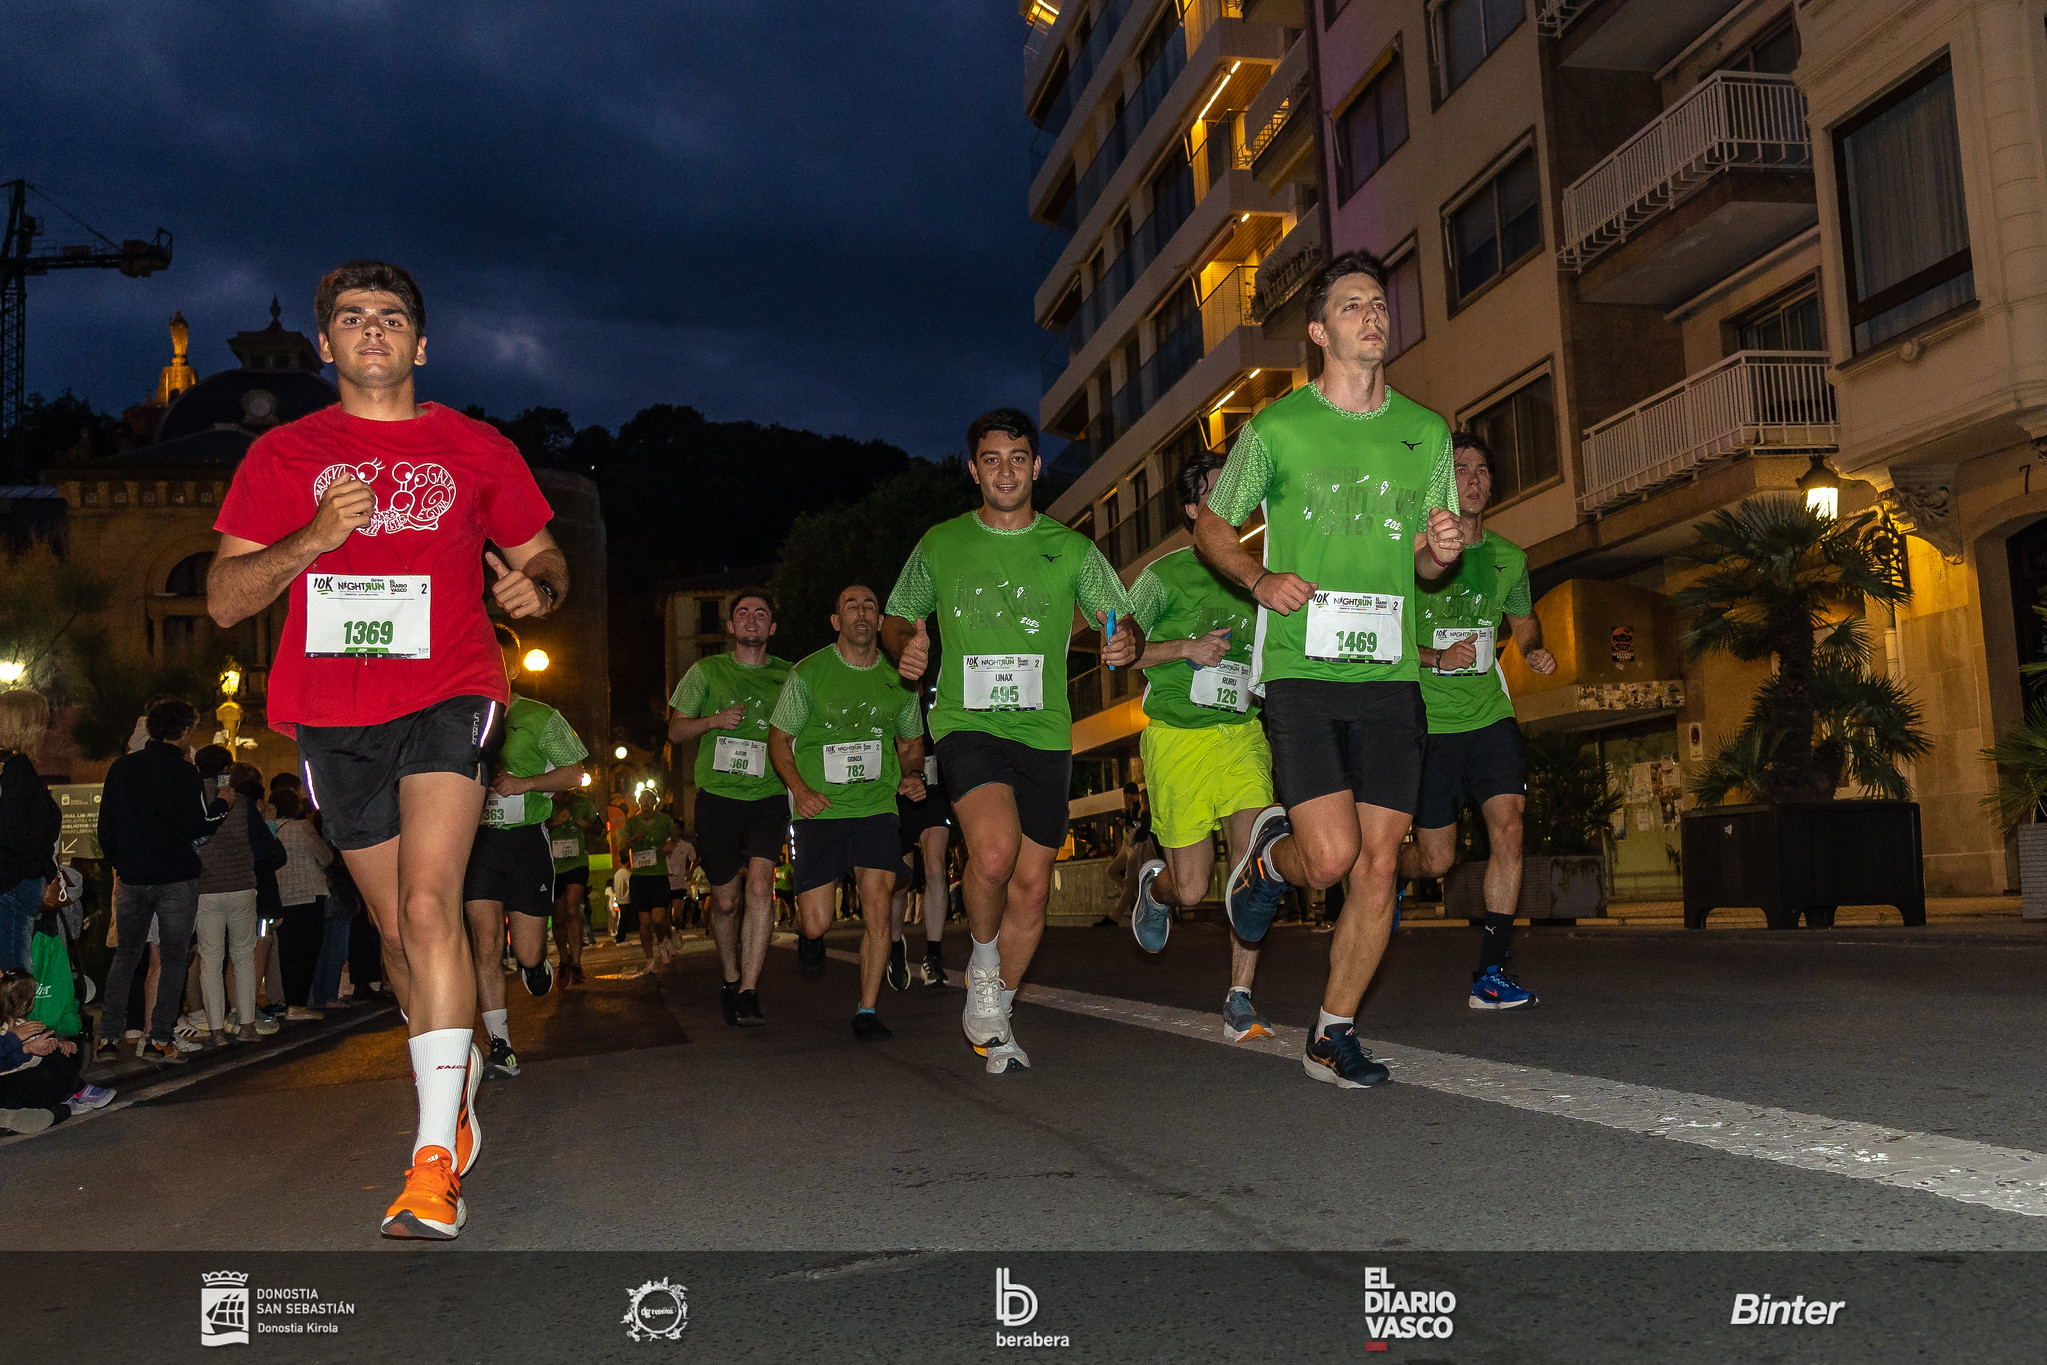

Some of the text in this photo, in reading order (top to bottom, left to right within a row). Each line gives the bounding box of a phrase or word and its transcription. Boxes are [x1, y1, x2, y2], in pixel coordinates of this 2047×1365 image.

[421, 583, 428, 594] 2
[1393, 602, 1398, 610] 2
[344, 621, 394, 645] 1369
[1336, 631, 1377, 653] 1469
[1035, 660, 1040, 668] 2
[990, 686, 1019, 703] 495
[1217, 687, 1238, 705] 126
[730, 758, 749, 770] 360
[846, 764, 865, 777] 782
